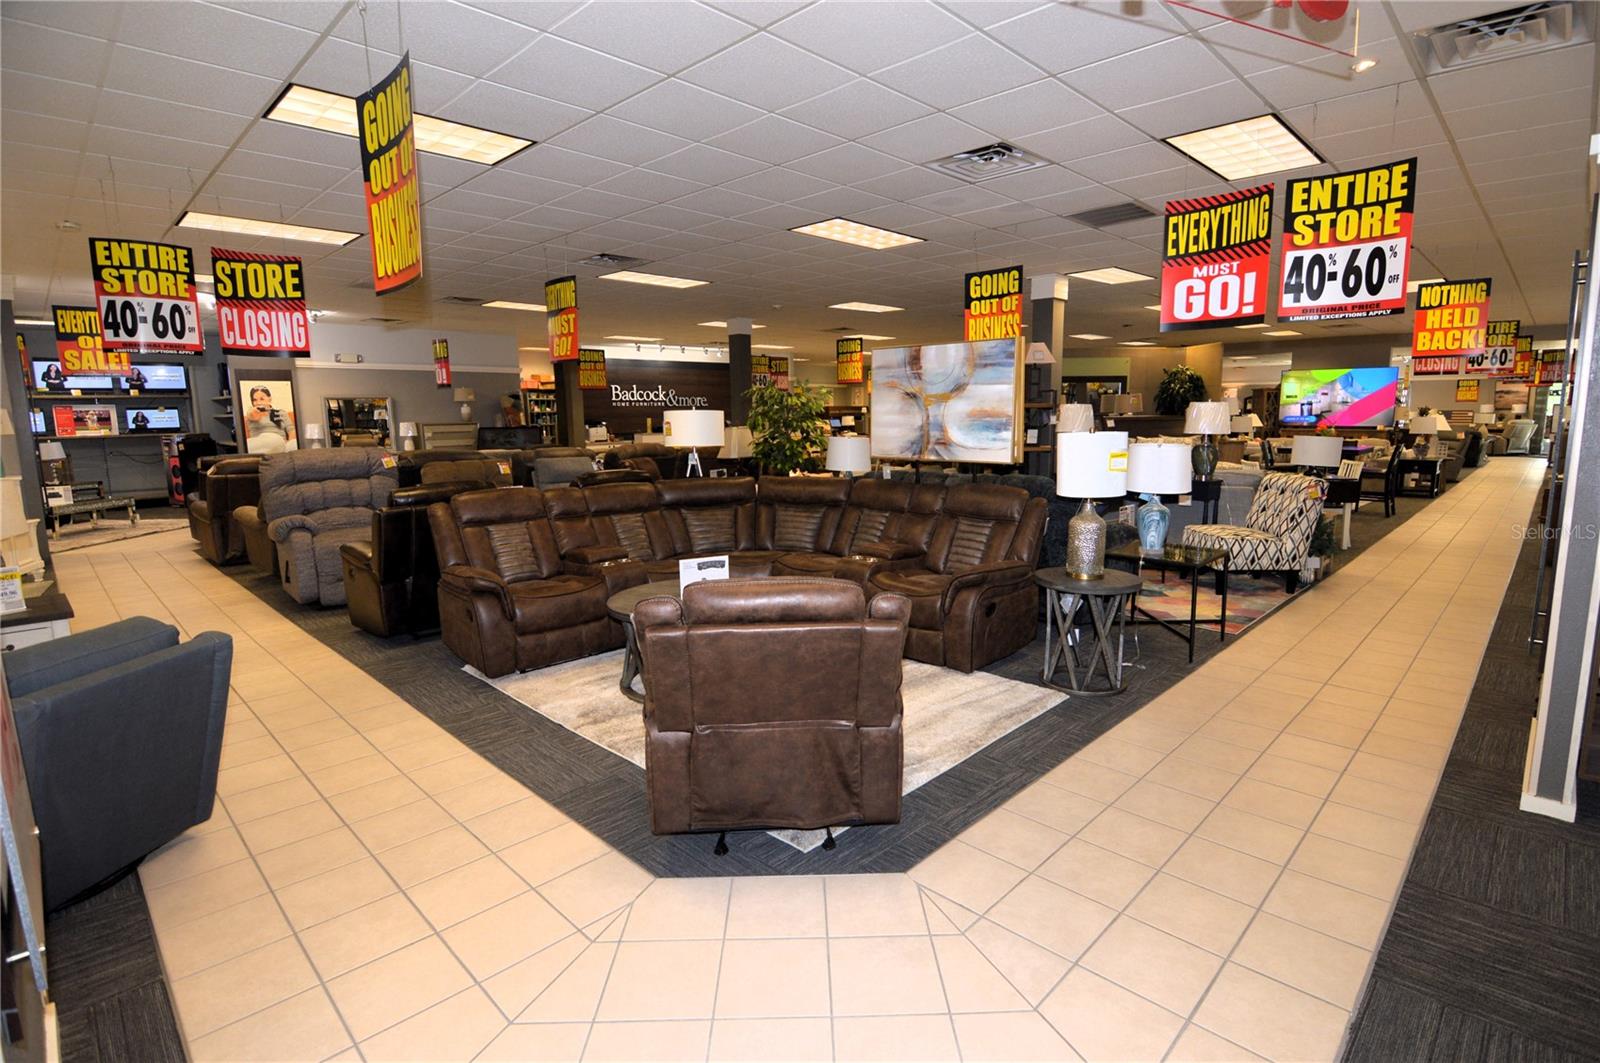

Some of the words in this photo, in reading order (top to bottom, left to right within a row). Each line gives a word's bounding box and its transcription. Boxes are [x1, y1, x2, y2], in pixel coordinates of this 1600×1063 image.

[362, 66, 410, 154] GOING
[369, 147, 399, 195] OUT
[400, 133, 414, 176] OF
[1291, 163, 1409, 213] ENTIRE
[1167, 194, 1270, 257] EVERYTHING
[1293, 201, 1402, 247] STORE
[95, 241, 190, 273] ENTIRE
[1193, 261, 1240, 278] MUST
[101, 268, 189, 298] STORE
[215, 260, 302, 299] STORE
[969, 270, 1020, 299] GOING
[1388, 273, 1400, 284] OFF
[970, 299, 998, 316] OUT
[1002, 295, 1018, 313] OF
[1173, 271, 1257, 320] GO!
[1420, 281, 1487, 308] NOTHING
[1302, 306, 1349, 314] ORIGINAL
[1351, 303, 1381, 311] PRICE
[1321, 311, 1367, 320] EXCEPTIONS
[1368, 309, 1392, 317] APPLY
[1425, 306, 1480, 329] HELD
[220, 306, 305, 348] CLOSING
[968, 313, 1020, 341] BUSINESS
[1416, 328, 1486, 351] BACK!
[1487, 321, 1518, 334] TIRE
[553, 336, 572, 357] GO!
[579, 351, 604, 361] GOING
[839, 340, 861, 353] GOING
[64, 349, 128, 371] SALE!
[611, 384, 666, 401] Badcock
